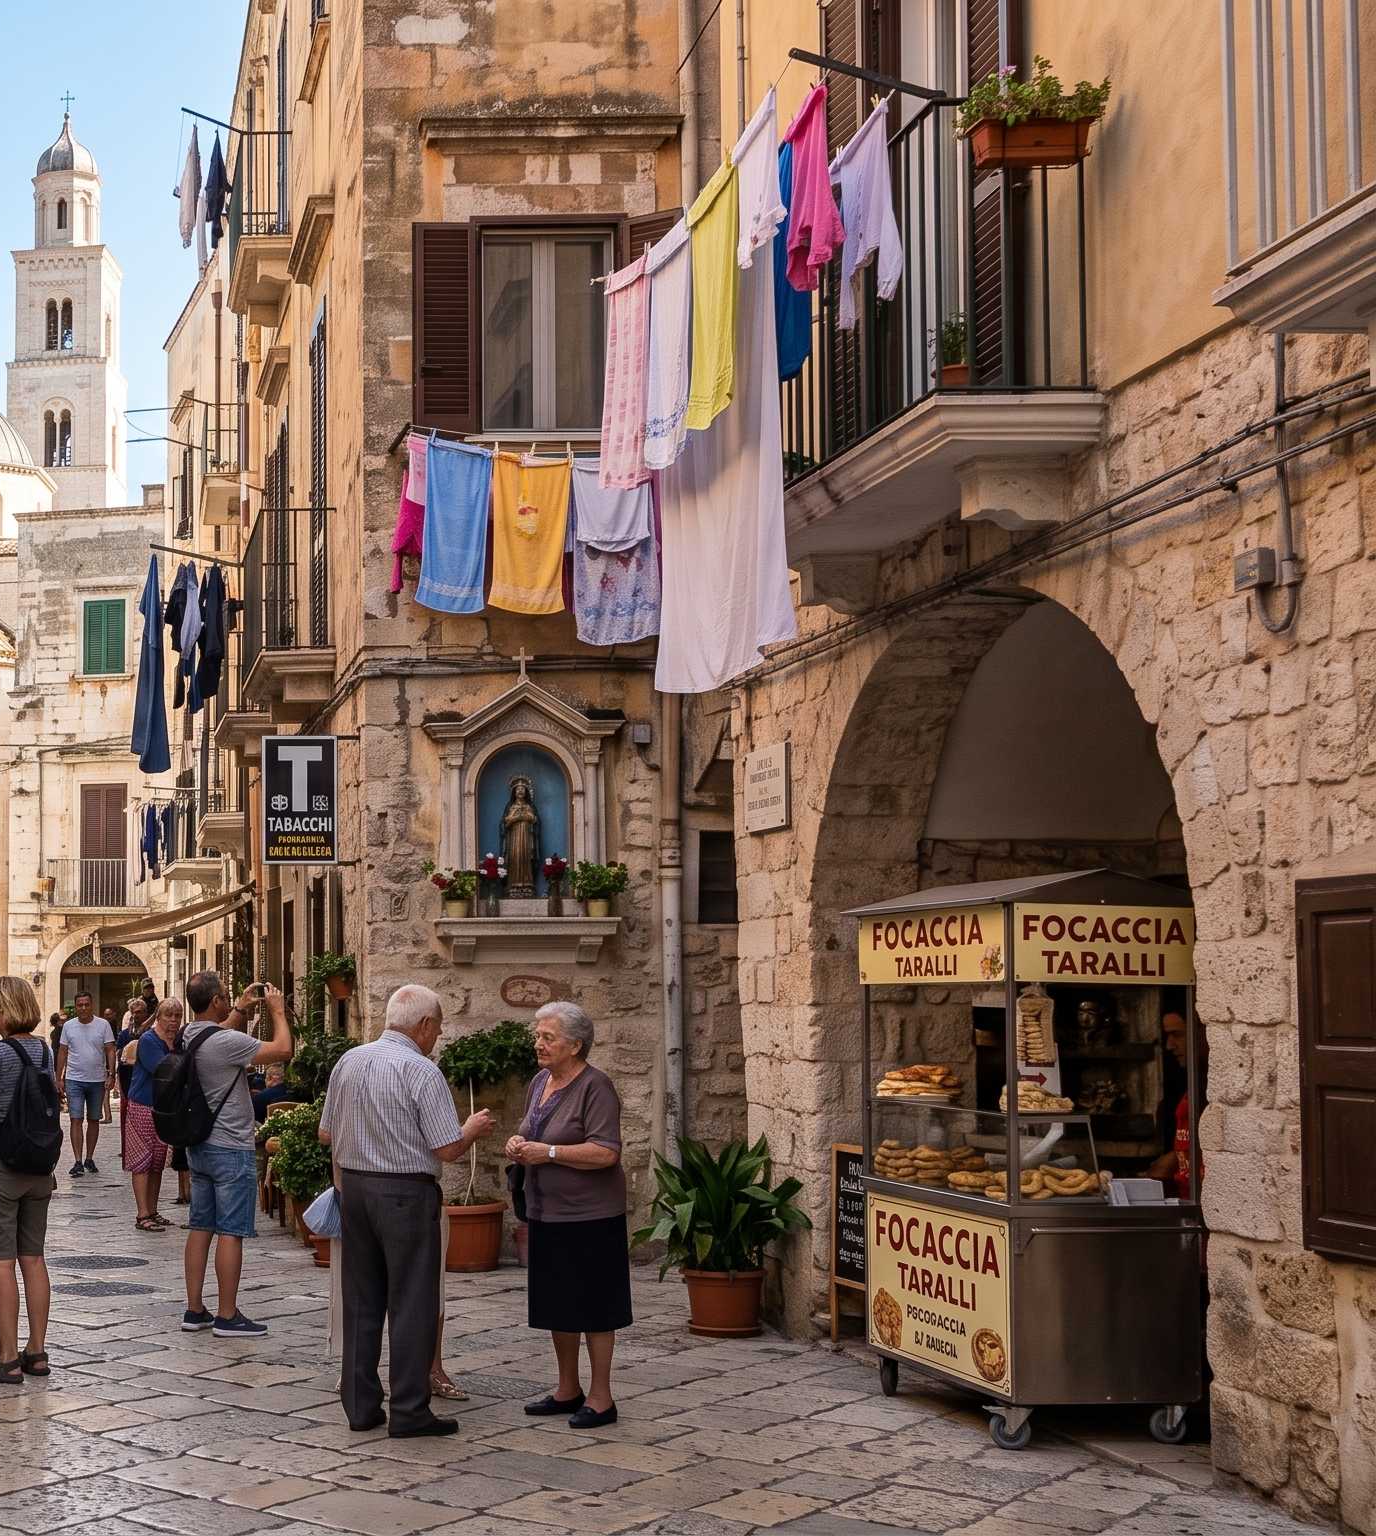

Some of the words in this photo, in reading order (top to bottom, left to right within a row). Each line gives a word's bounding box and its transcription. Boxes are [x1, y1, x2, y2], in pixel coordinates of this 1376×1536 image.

[278, 746, 322, 812] T
[267, 817, 332, 832] TABACCHI
[873, 913, 984, 951] FOCACCIA
[1023, 914, 1187, 945] FOCACCIA
[895, 954, 958, 978] TARALLI
[1041, 950, 1165, 976] TARALLI
[875, 1210, 1001, 1278] FOCACCIA
[897, 1262, 977, 1312] TARALLI
